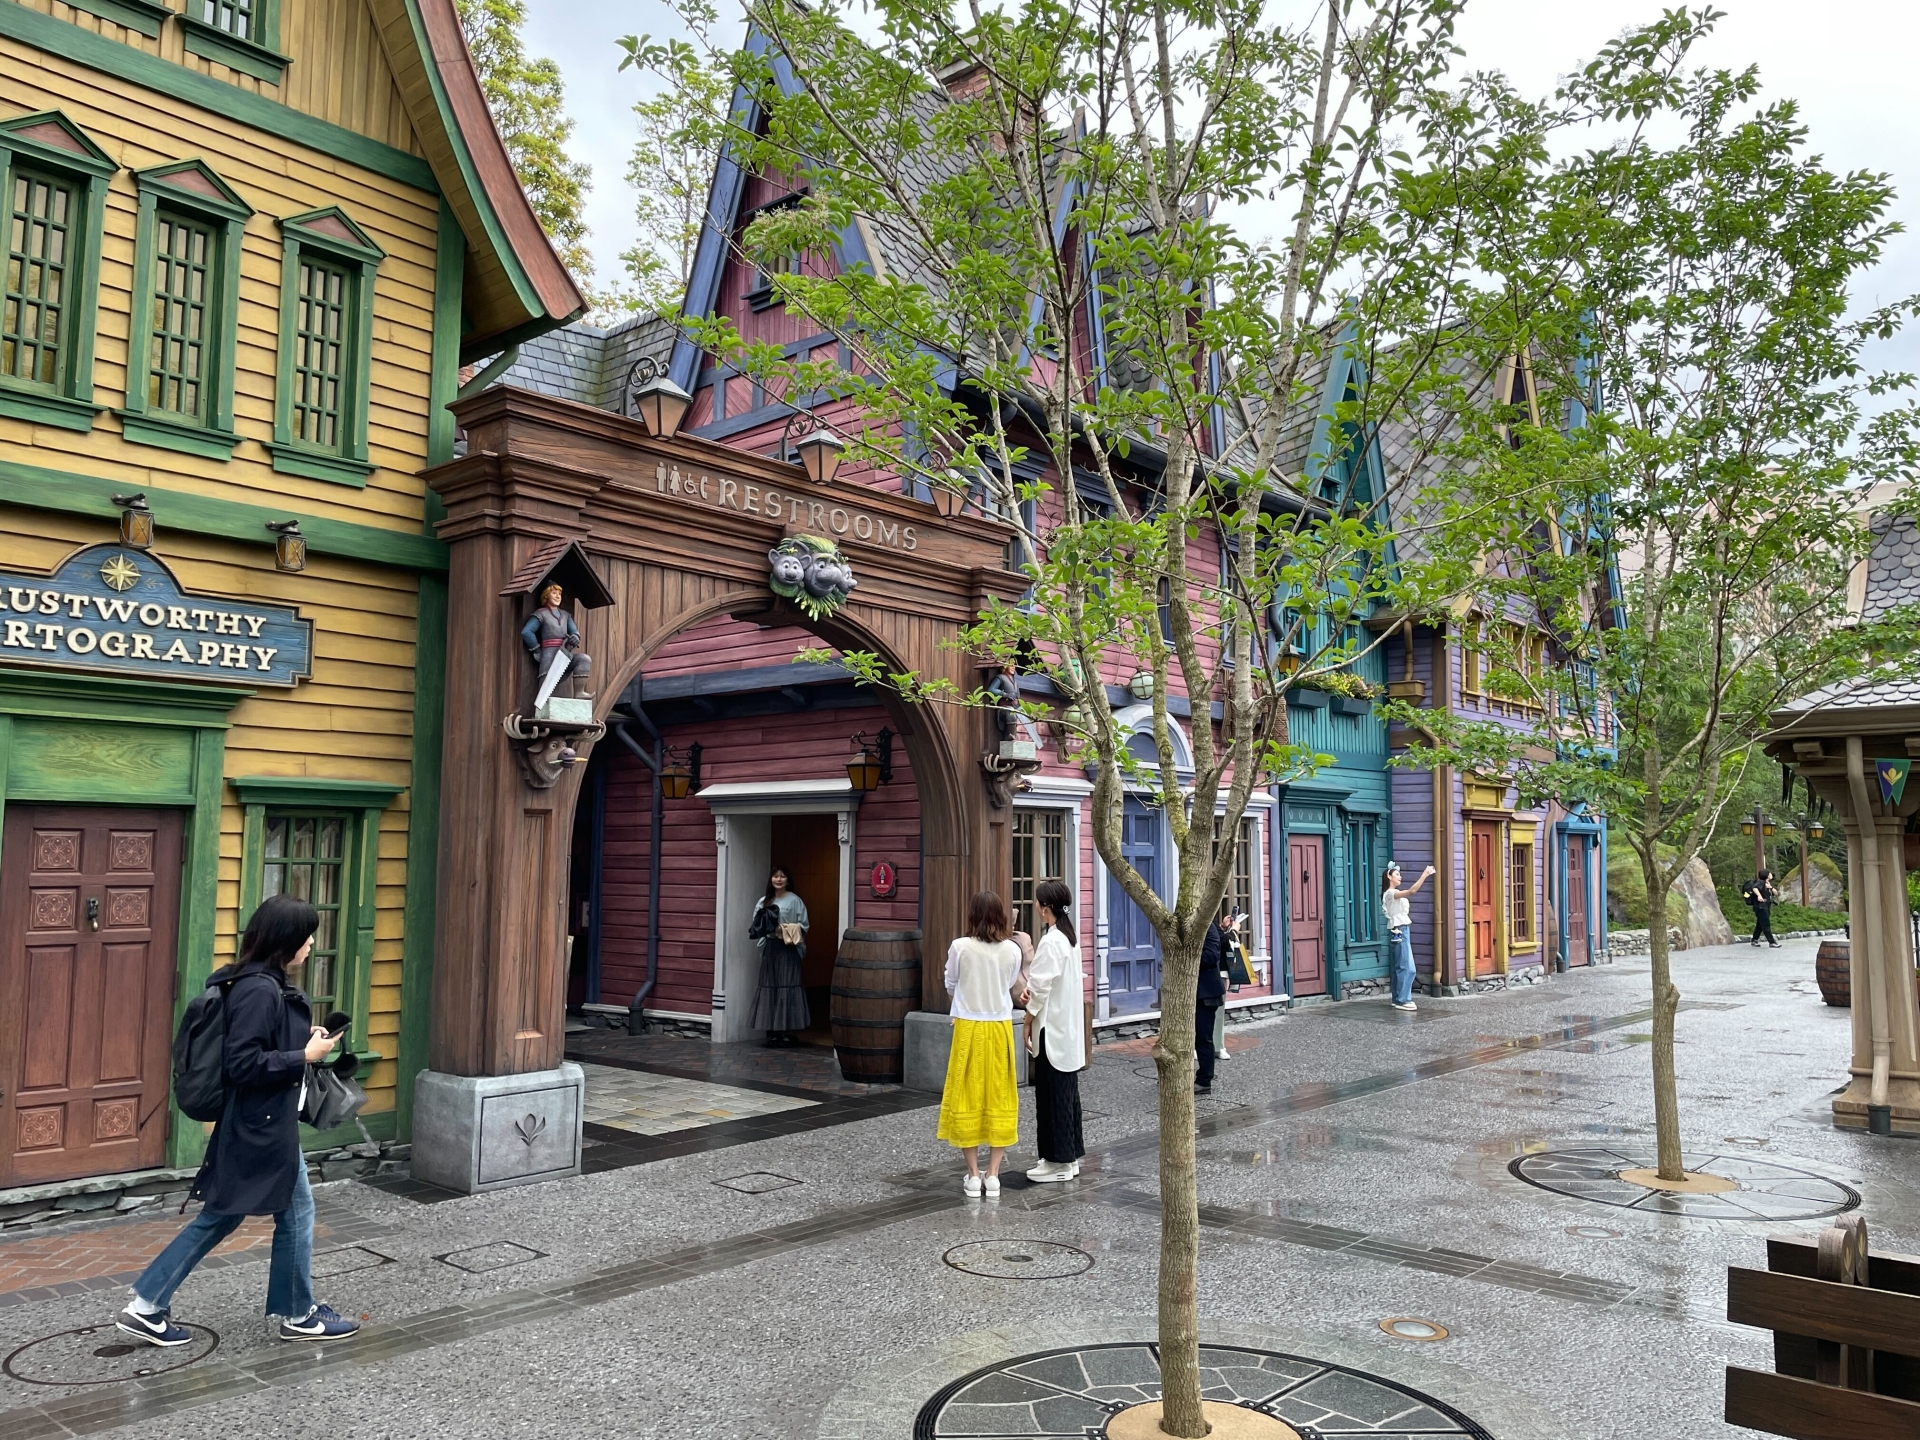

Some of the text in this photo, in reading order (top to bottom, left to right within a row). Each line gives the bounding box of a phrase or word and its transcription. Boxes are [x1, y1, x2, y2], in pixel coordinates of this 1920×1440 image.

[718, 477, 918, 551] RESTROOMS
[0, 586, 267, 638] USTWORTHY
[3, 619, 278, 671] RTOGRAPHY
